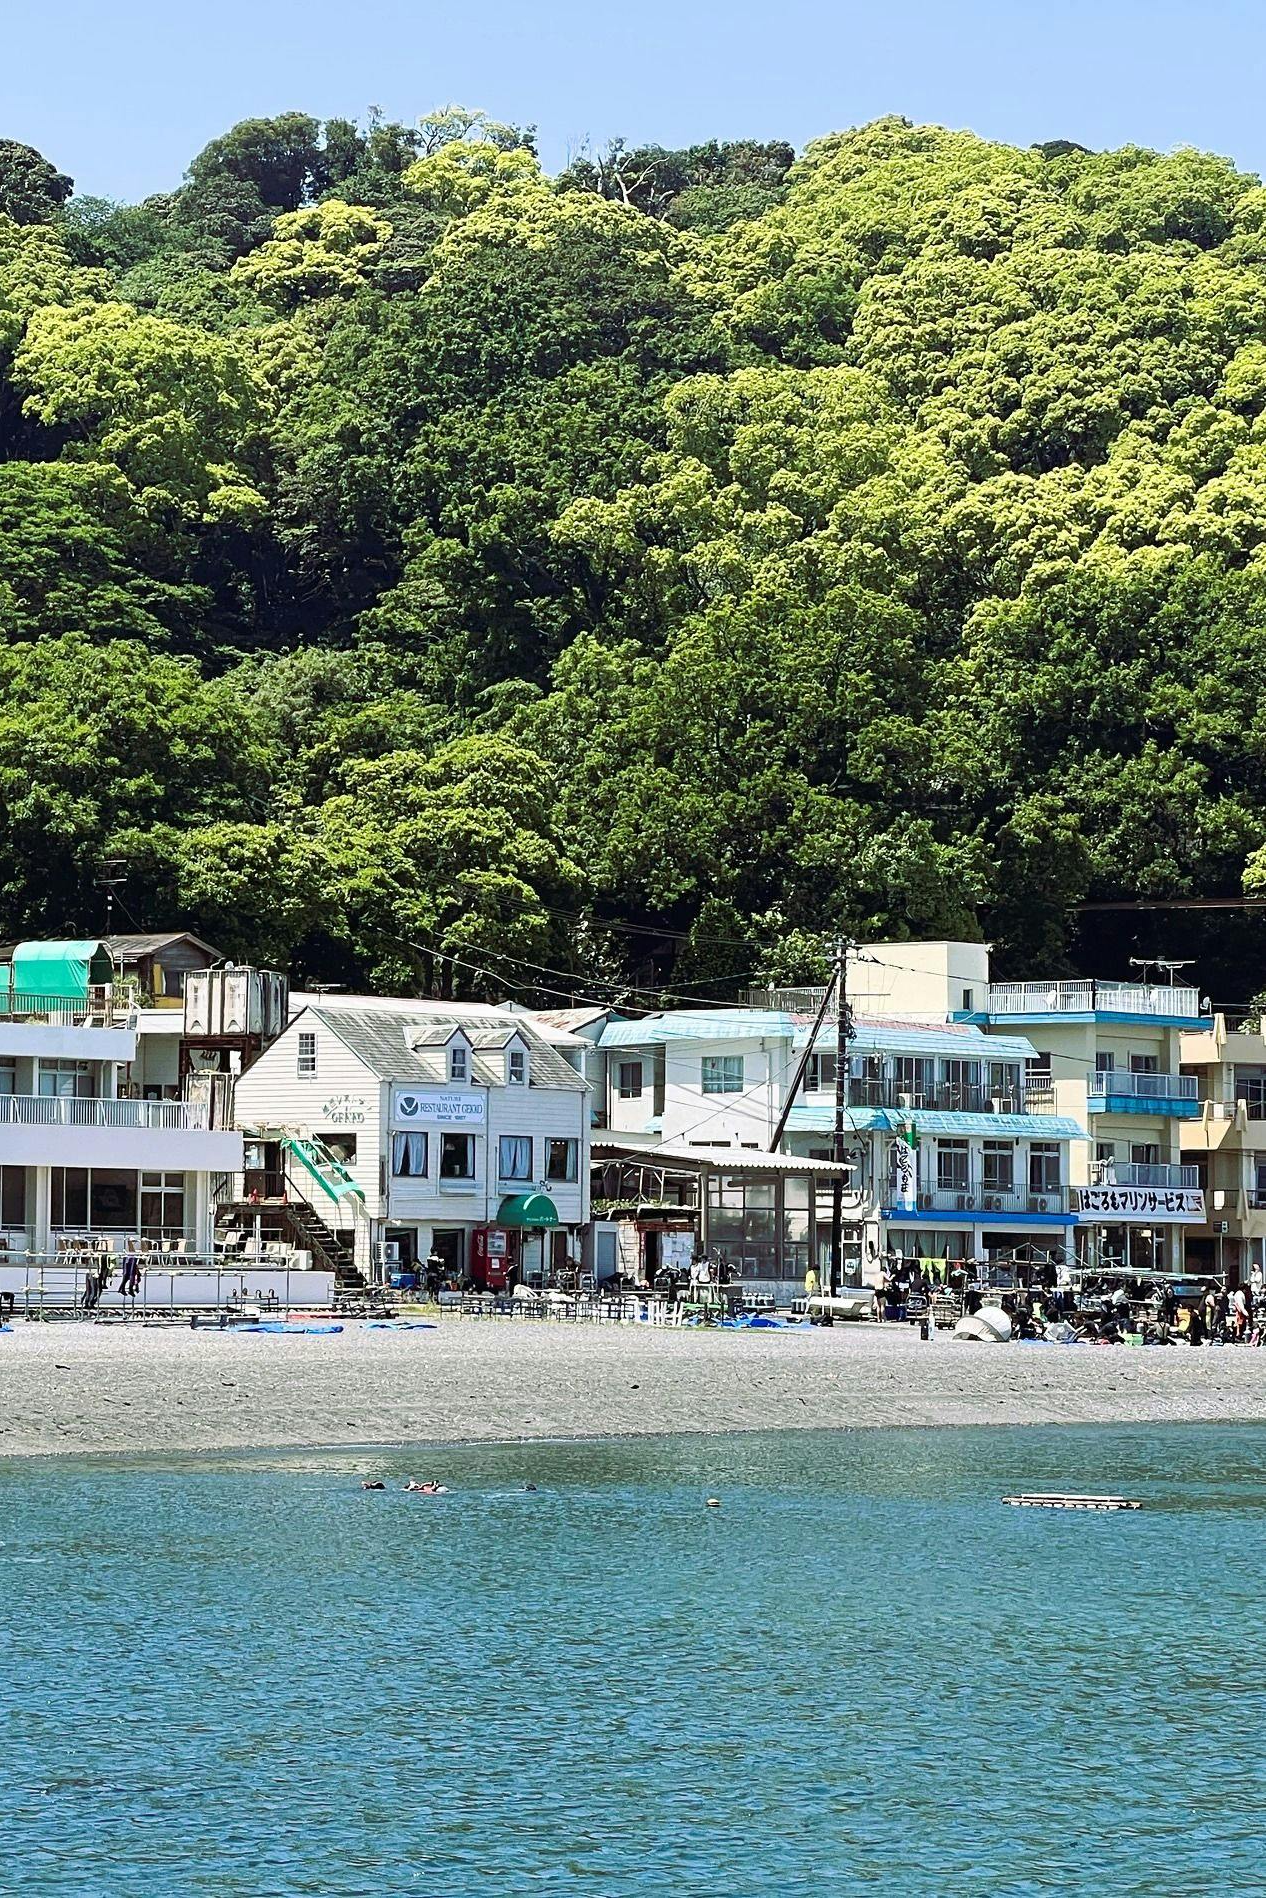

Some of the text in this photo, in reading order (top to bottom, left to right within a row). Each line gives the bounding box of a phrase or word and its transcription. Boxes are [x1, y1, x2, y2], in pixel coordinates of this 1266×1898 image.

[420, 1102, 461, 1114] RESTAURANT
[1079, 1189, 1186, 1212] はごろもマリンサービス
